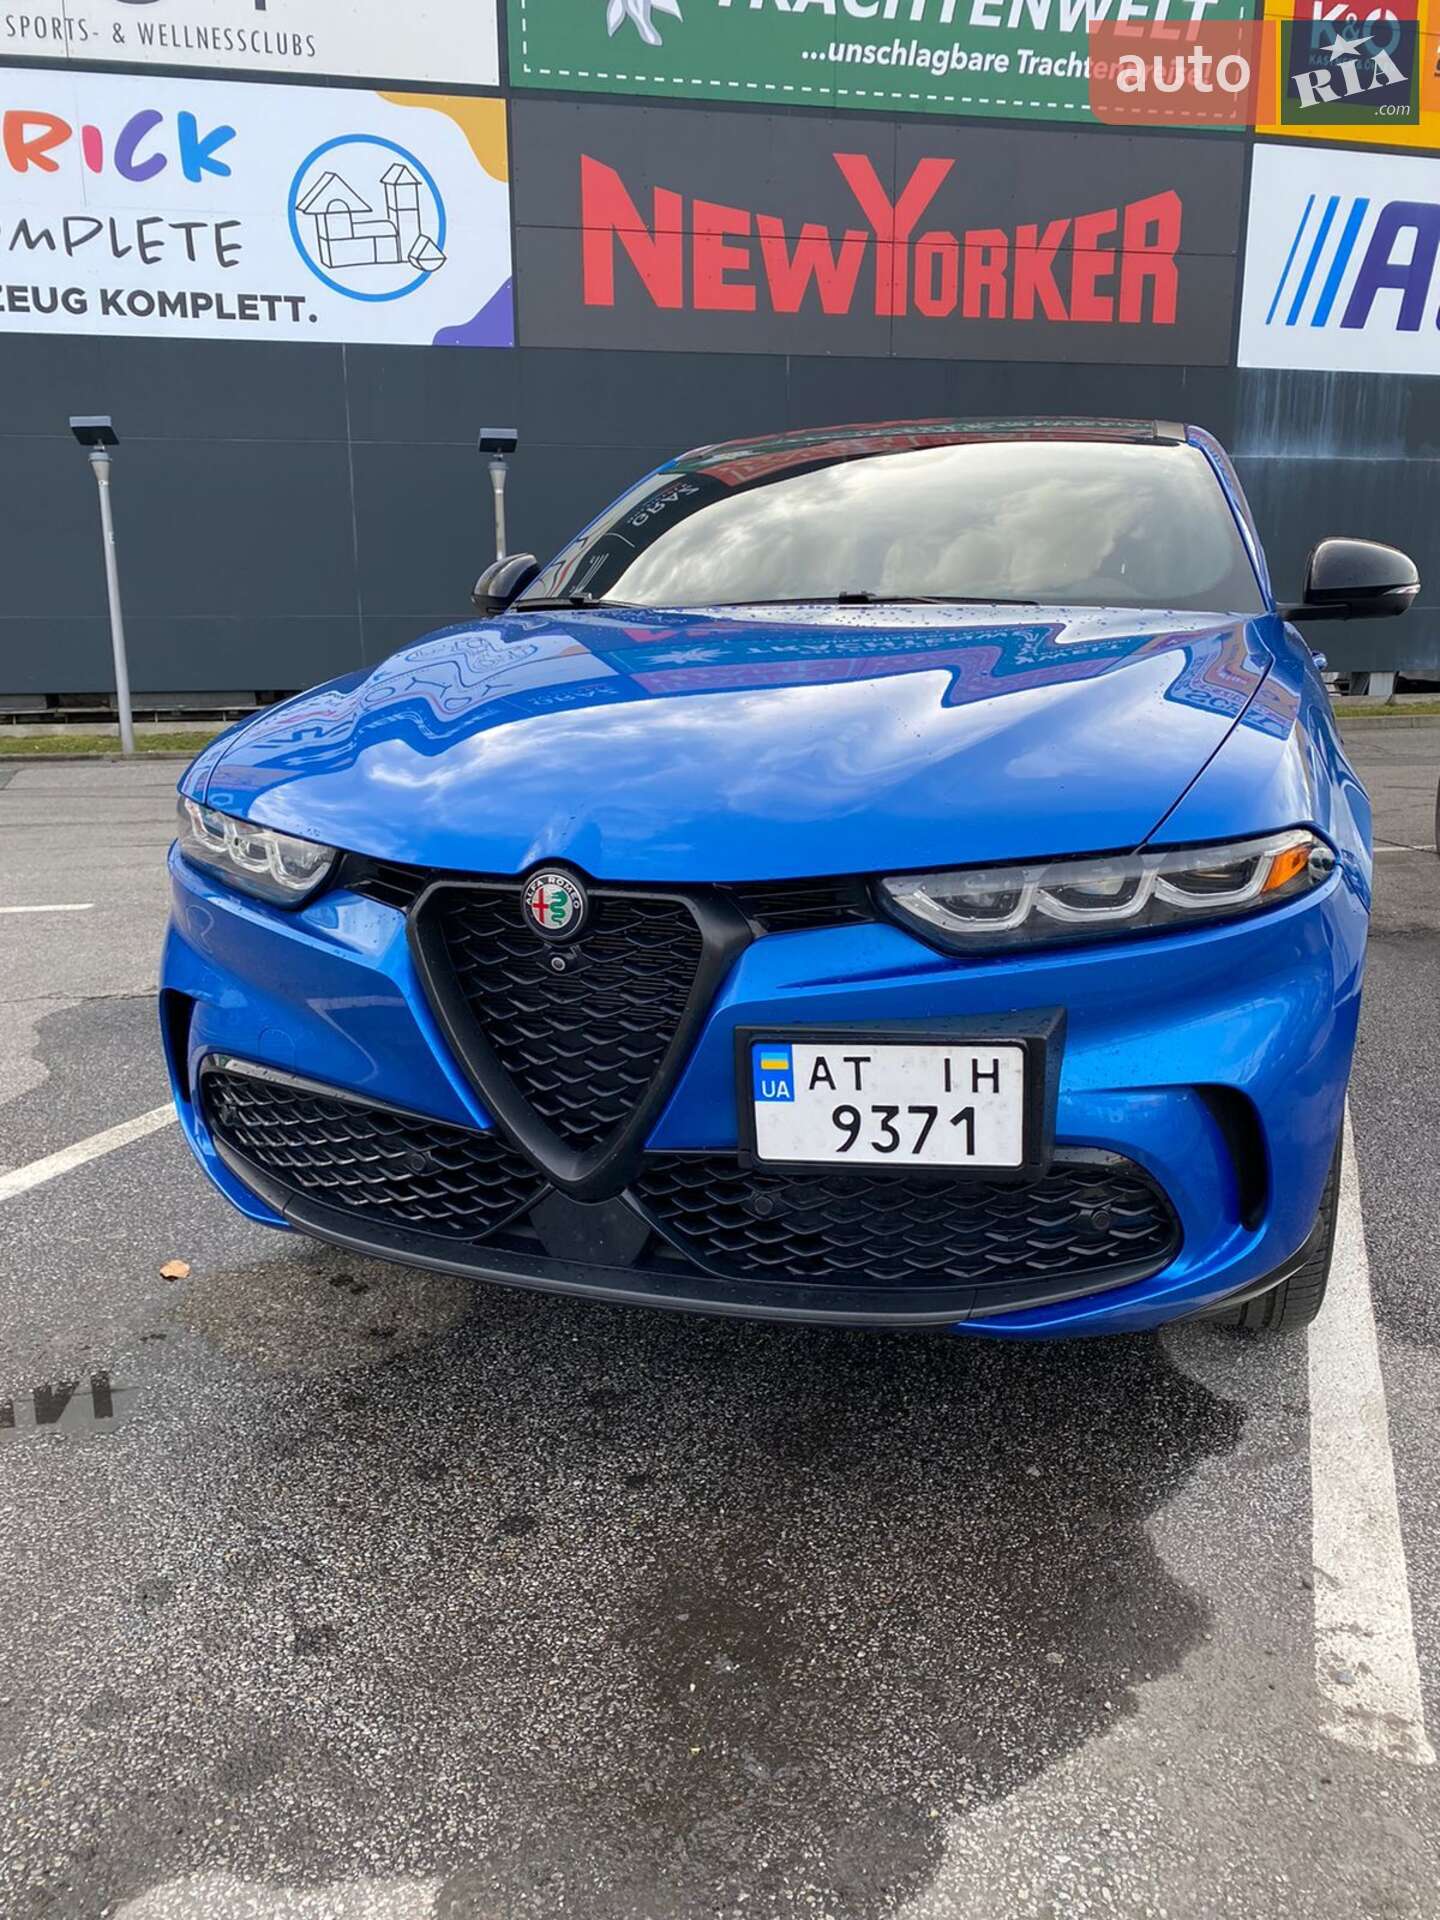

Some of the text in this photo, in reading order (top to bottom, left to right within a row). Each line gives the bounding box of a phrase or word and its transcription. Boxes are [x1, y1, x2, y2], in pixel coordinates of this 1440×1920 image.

[5, 14, 316, 57] SPORTS- & WELLNESSCLUBS
[0, 215, 243, 268] MPLETE
[0, 284, 318, 323] EUG KOMPLETT.
[527, 877, 580, 909] ALFA ROMEO
[761, 1080, 790, 1099] UA
[832, 1104, 976, 1156] 9371
